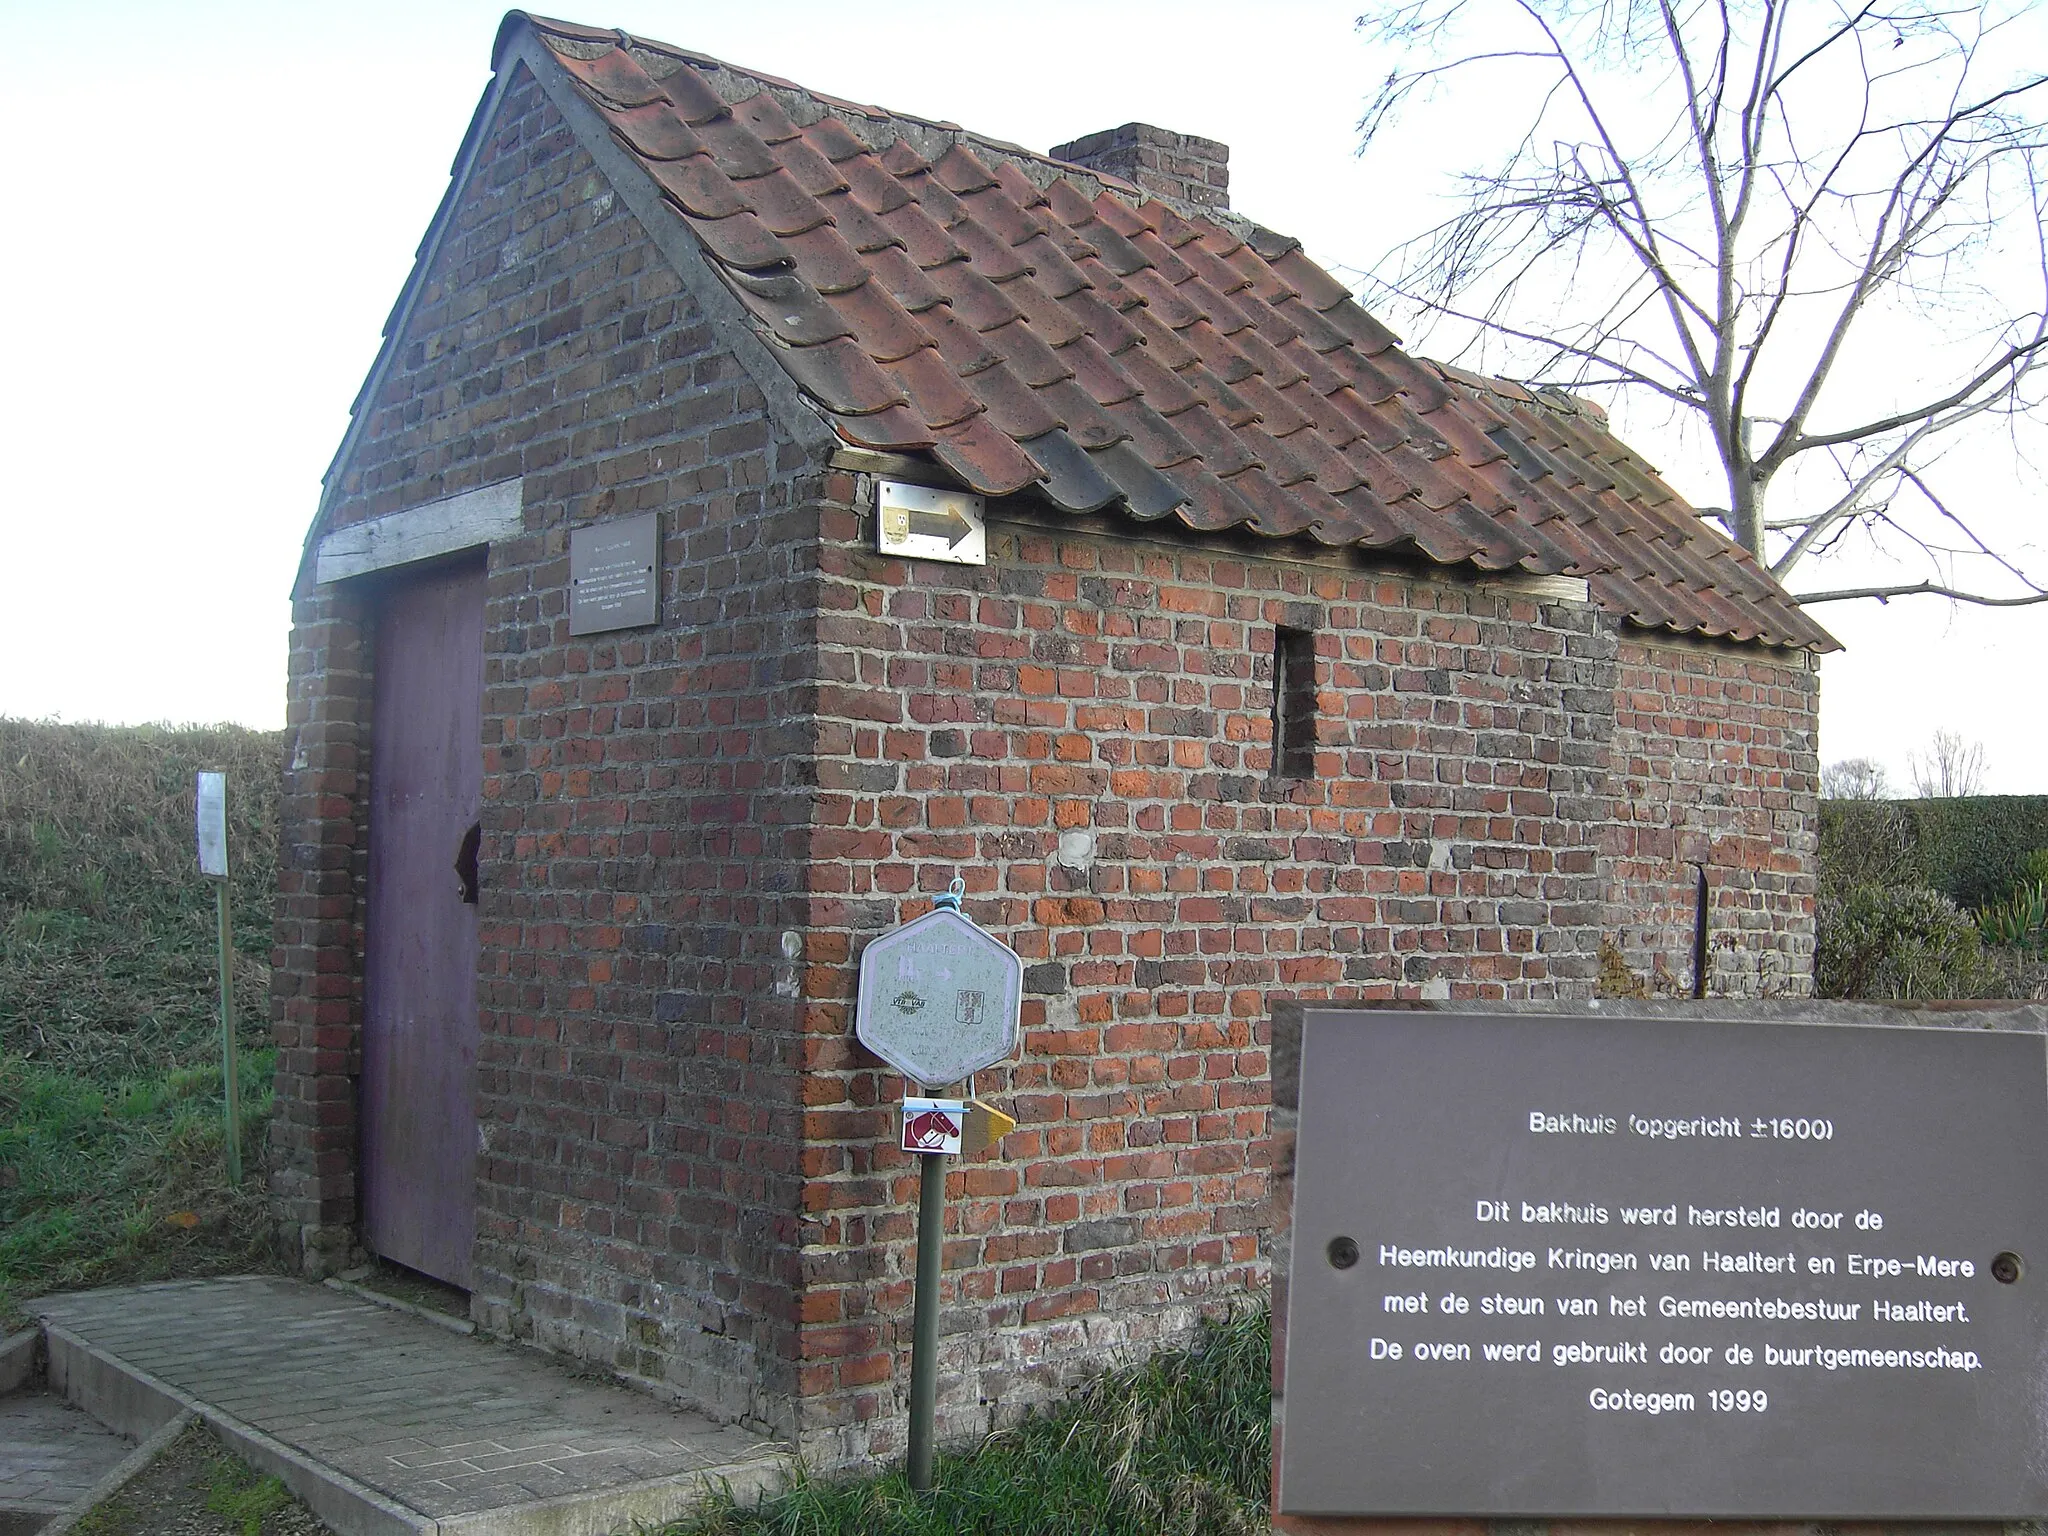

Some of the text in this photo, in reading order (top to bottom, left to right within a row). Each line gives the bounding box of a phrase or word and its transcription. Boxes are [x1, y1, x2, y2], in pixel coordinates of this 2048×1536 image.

[1530, 1112, 1833, 1140] Bakhuis (opgericht ±1600)
[1477, 1201, 1883, 1230] Dit bakhuis werd hersteld door de
[1380, 1245, 1974, 1279] Heemkundige Kringen van Haaltert en Erpe-Mere
[1384, 1292, 1969, 1322] met de steun van het Gemeentebestuur Haaltert.
[1371, 1338, 1982, 1370] De oven werd gebruikt door de buurtgemeenschap.
[1590, 1388, 1767, 1414] Gotegem 1999
